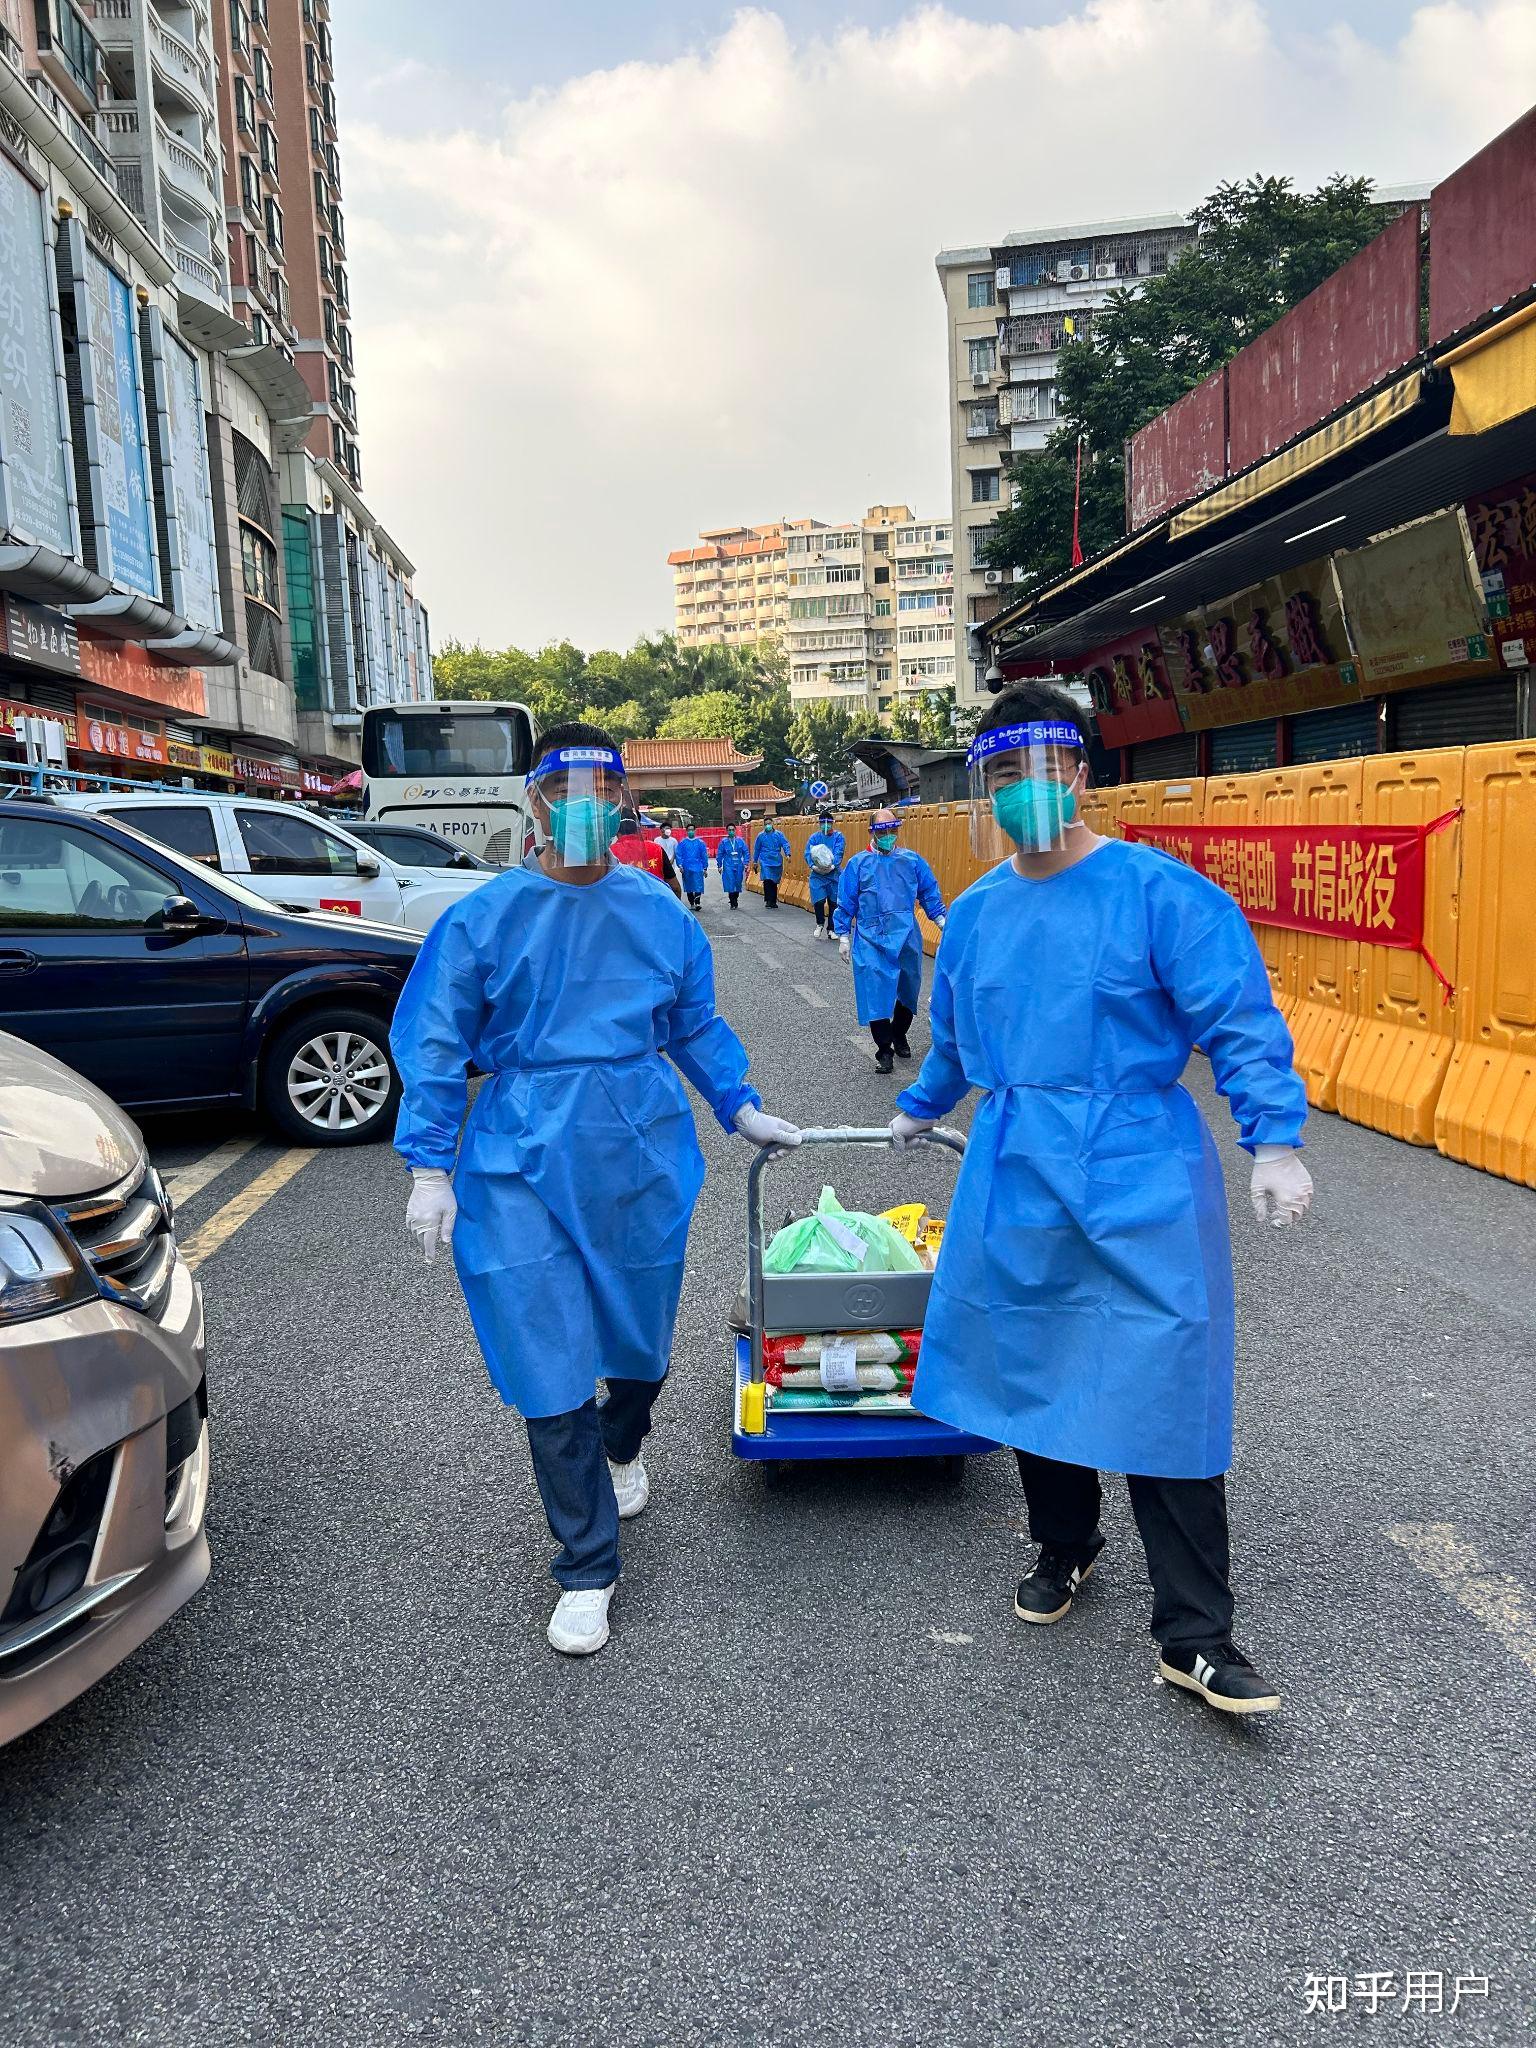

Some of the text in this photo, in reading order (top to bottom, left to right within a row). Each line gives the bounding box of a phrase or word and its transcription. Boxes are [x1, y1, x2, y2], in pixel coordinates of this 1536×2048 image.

[1474, 643, 1481, 656] 3
[973, 736, 996, 756] FACE
[1034, 727, 1078, 741] SHIELD
[442, 822, 487, 835] FP071
[1204, 836, 1276, 912] 守望相助
[1291, 839, 1397, 930] 并肩战役
